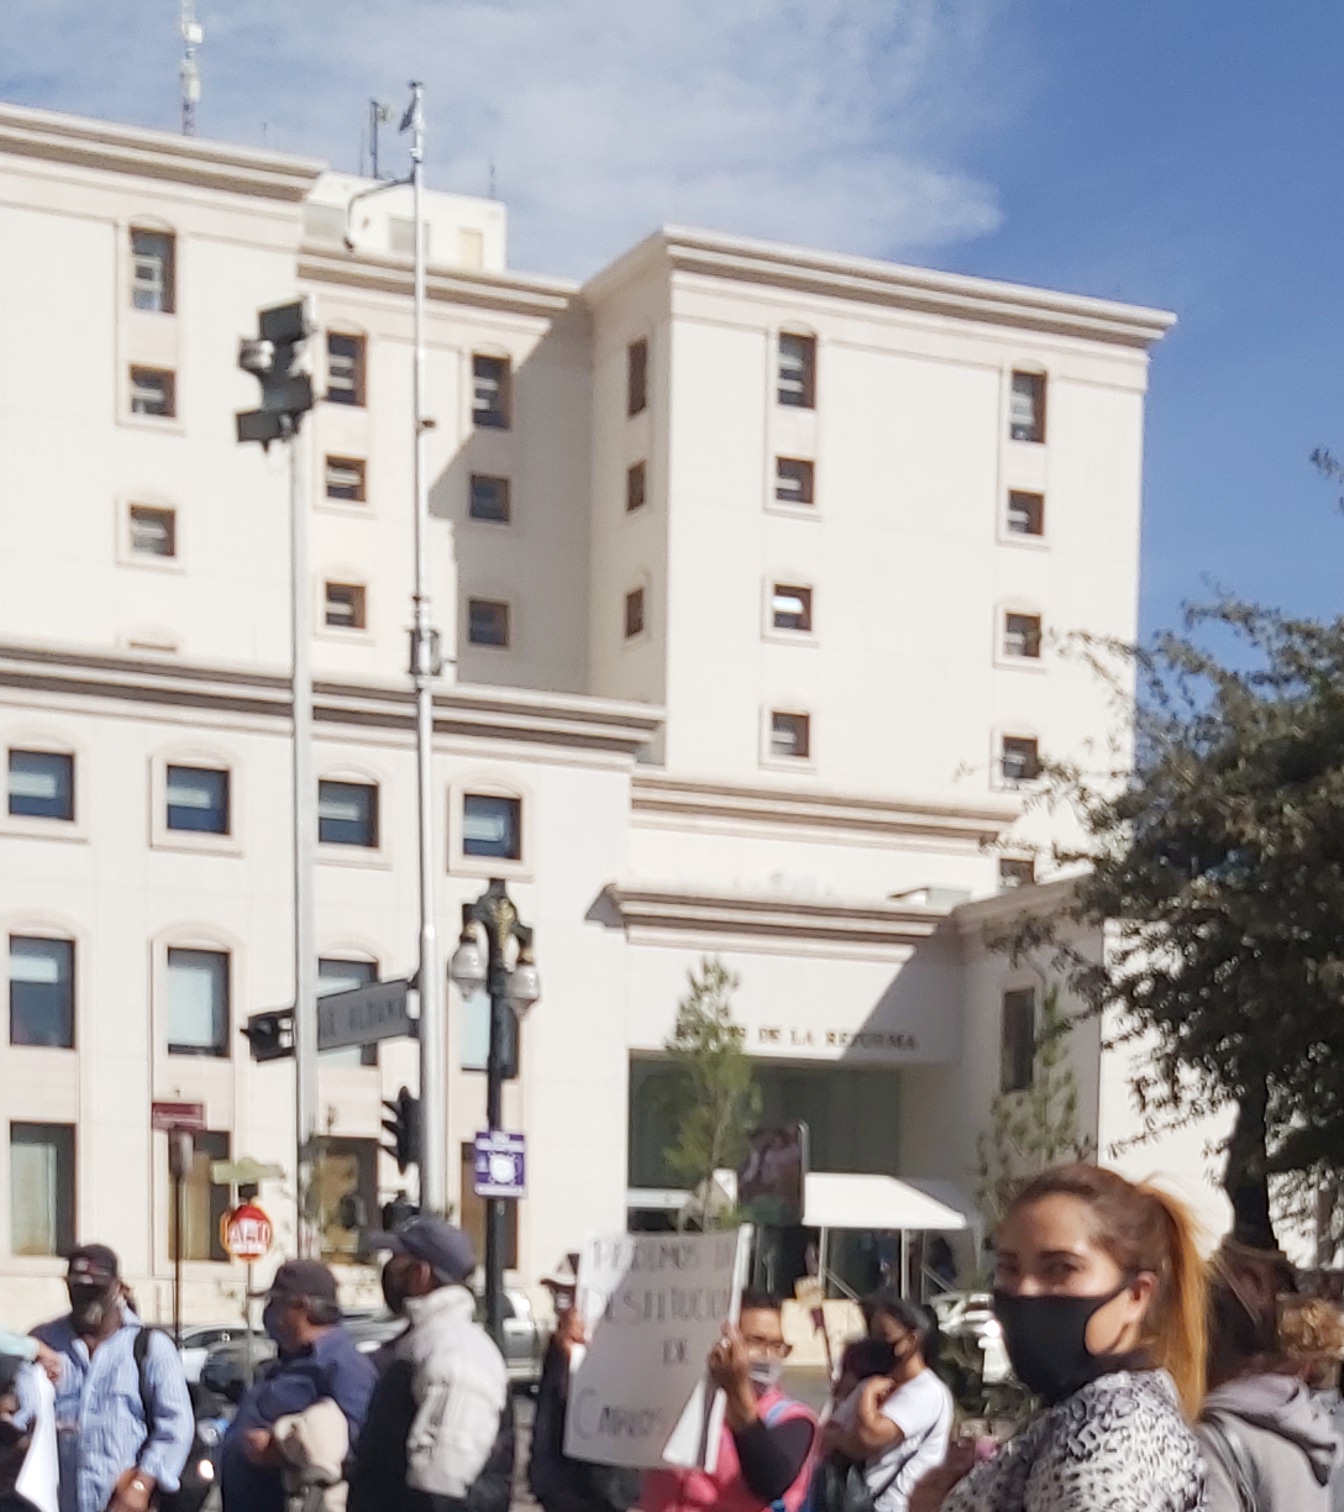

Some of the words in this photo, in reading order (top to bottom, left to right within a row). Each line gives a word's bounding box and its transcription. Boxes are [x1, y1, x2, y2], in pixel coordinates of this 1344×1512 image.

[758, 1027, 780, 1042] DE
[790, 1029, 813, 1046] LA
[824, 1030, 918, 1050] REFORMA
